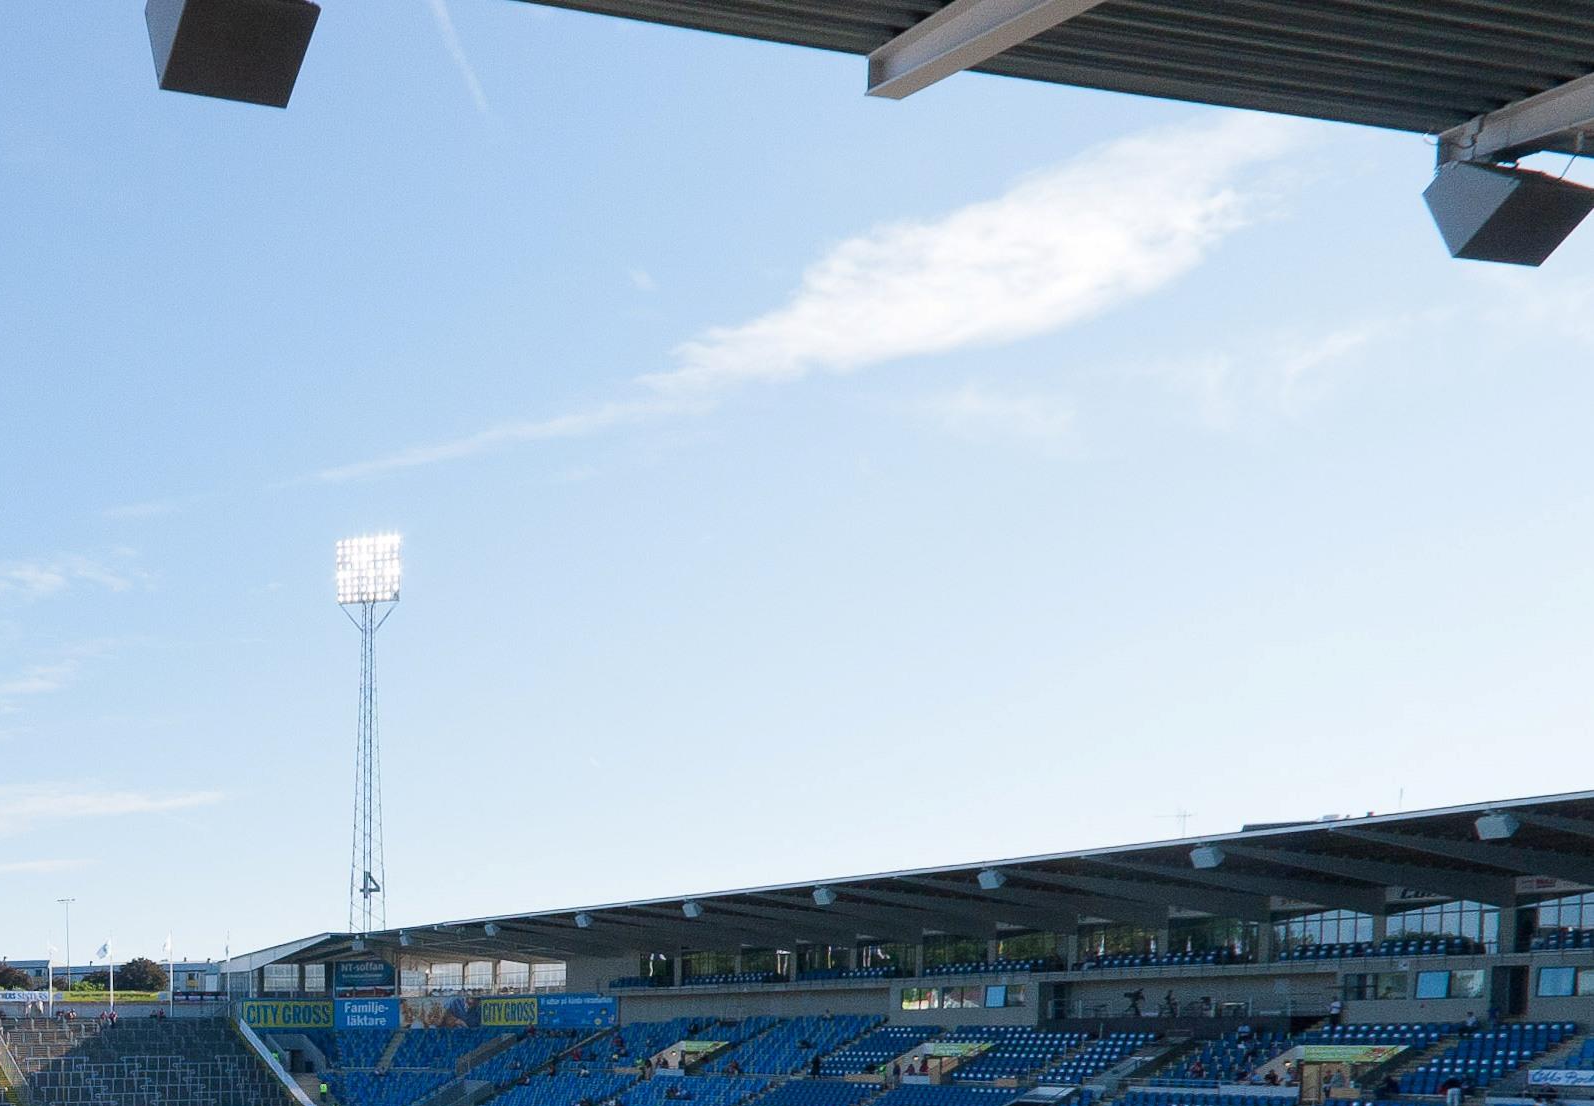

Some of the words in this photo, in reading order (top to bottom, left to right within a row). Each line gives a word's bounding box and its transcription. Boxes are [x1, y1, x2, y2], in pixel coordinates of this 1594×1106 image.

[247, 1004, 280, 1025] CITY
[282, 1004, 331, 1025] GROSS
[344, 1002, 389, 1016] Familje-
[483, 1002, 503, 1022] CITY
[505, 1002, 536, 1021] GROSS
[347, 1015, 387, 1027] läktare
